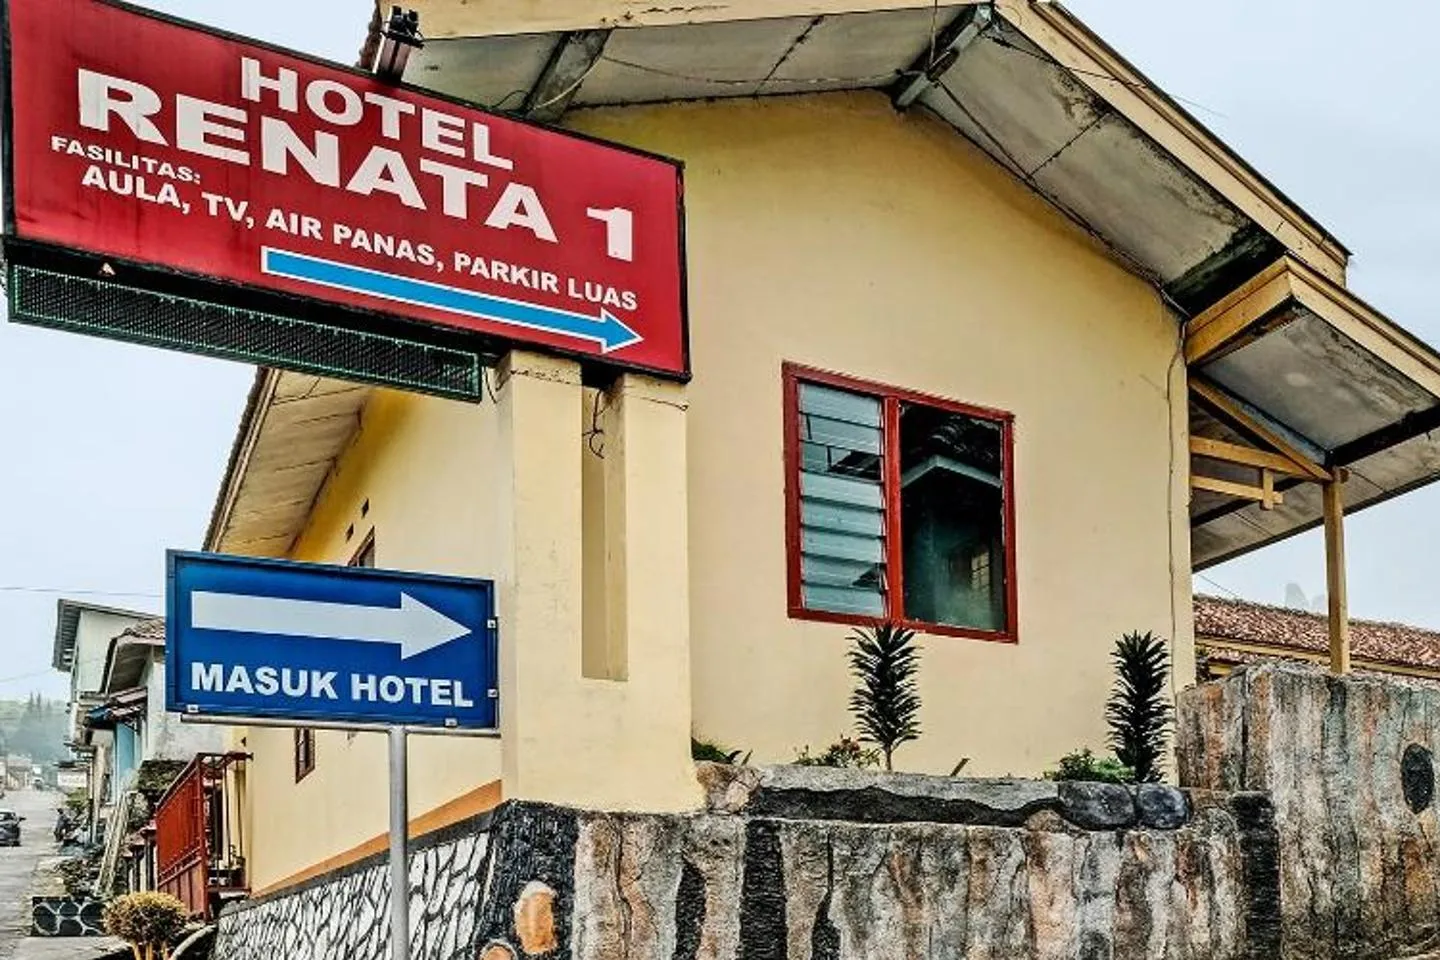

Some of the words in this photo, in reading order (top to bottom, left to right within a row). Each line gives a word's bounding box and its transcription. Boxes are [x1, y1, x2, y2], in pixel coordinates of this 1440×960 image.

[51, 135, 201, 183] FASILITAS:
[78, 68, 558, 243] RENATA
[586, 207, 634, 262] 1
[241, 56, 514, 170] HOTEL
[81, 164, 190, 216] AULA,
[201, 191, 254, 229] TV,
[265, 208, 322, 241] AIR
[333, 223, 444, 273] PANAS,
[454, 251, 560, 294] PARKIR
[568, 278, 638, 311] LUAS
[191, 662, 338, 699] MASUK
[351, 673, 474, 707] HOTEL
